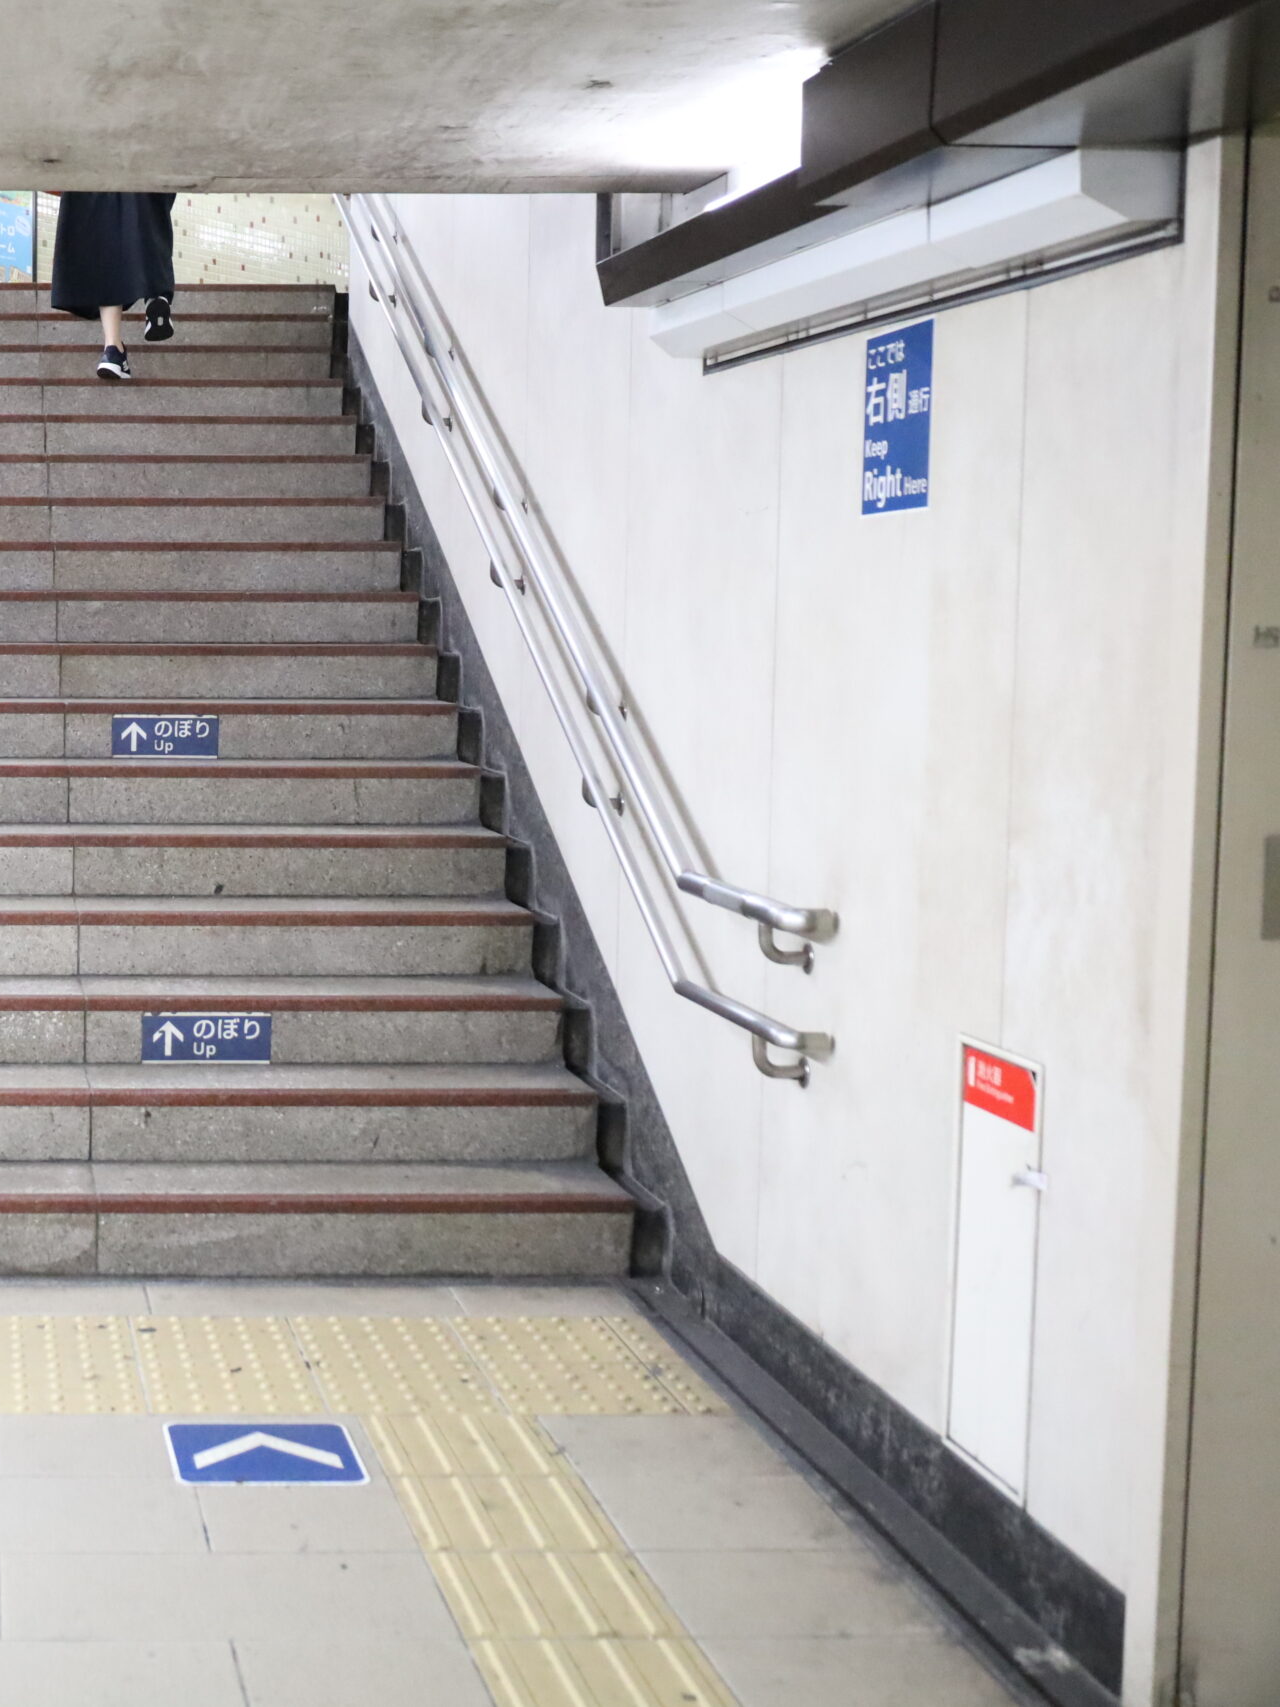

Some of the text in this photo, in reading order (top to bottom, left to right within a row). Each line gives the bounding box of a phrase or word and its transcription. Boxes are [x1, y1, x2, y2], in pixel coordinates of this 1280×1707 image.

[868, 339, 905, 369] ここでは
[865, 439, 888, 460] Keep
[864, 464, 928, 508] Right Here
[154, 719, 210, 738] のぼり
[154, 739, 174, 754] Up
[193, 1018, 261, 1040] のぼり
[193, 1042, 217, 1058] Up
